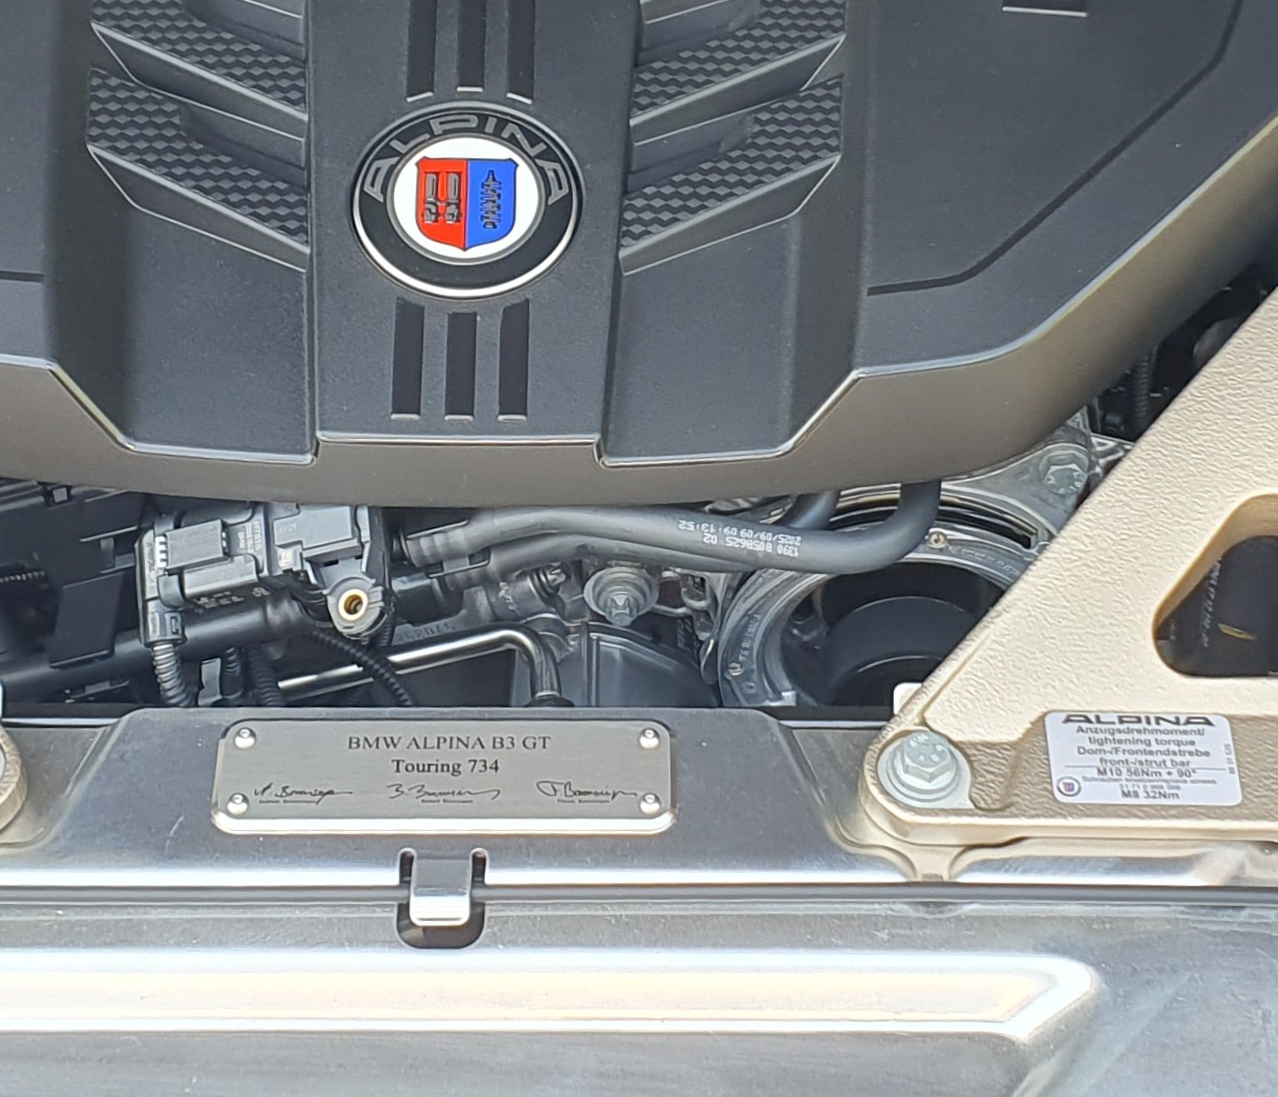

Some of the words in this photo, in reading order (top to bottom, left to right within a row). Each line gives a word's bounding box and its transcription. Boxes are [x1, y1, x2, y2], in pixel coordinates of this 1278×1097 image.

[364, 114, 569, 206] ALPINA
[703, 532, 718, 545] 02
[1062, 714, 1216, 727] ALPINA
[347, 736, 402, 750] BMW
[405, 736, 485, 750] ALPINA
[491, 736, 516, 750] B3
[522, 736, 552, 750] GT
[1088, 736, 1151, 747] tightening
[1155, 738, 1196, 747] torque
[391, 758, 462, 776] Touring
[467, 758, 500, 774] 734
[1170, 759, 1191, 768] bar
[1096, 767, 1123, 777] M10
[1143, 791, 1180, 800] 32Nm
